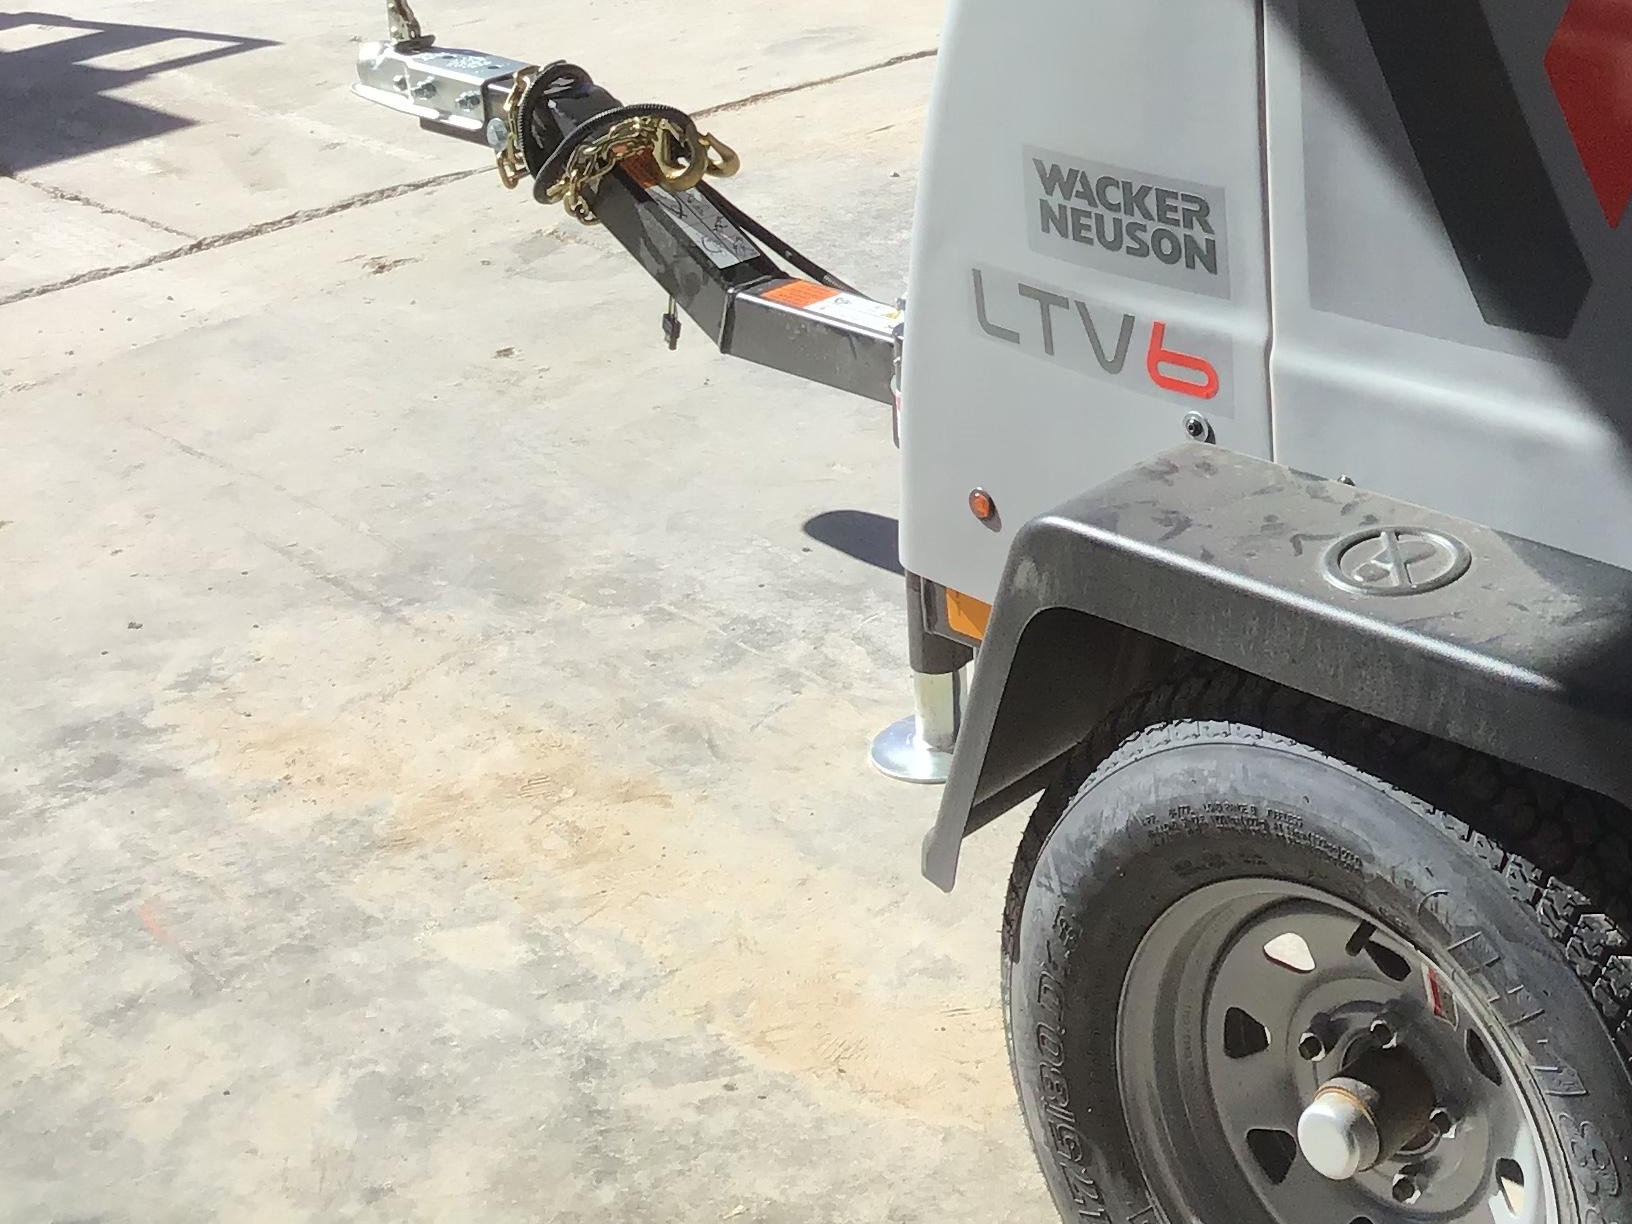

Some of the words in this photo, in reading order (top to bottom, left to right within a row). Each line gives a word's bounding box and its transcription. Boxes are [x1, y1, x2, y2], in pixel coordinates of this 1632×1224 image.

[1032, 158, 1215, 235] WACKER
[1040, 198, 1218, 275] NEUSON
[972, 267, 1220, 400] LTV6
